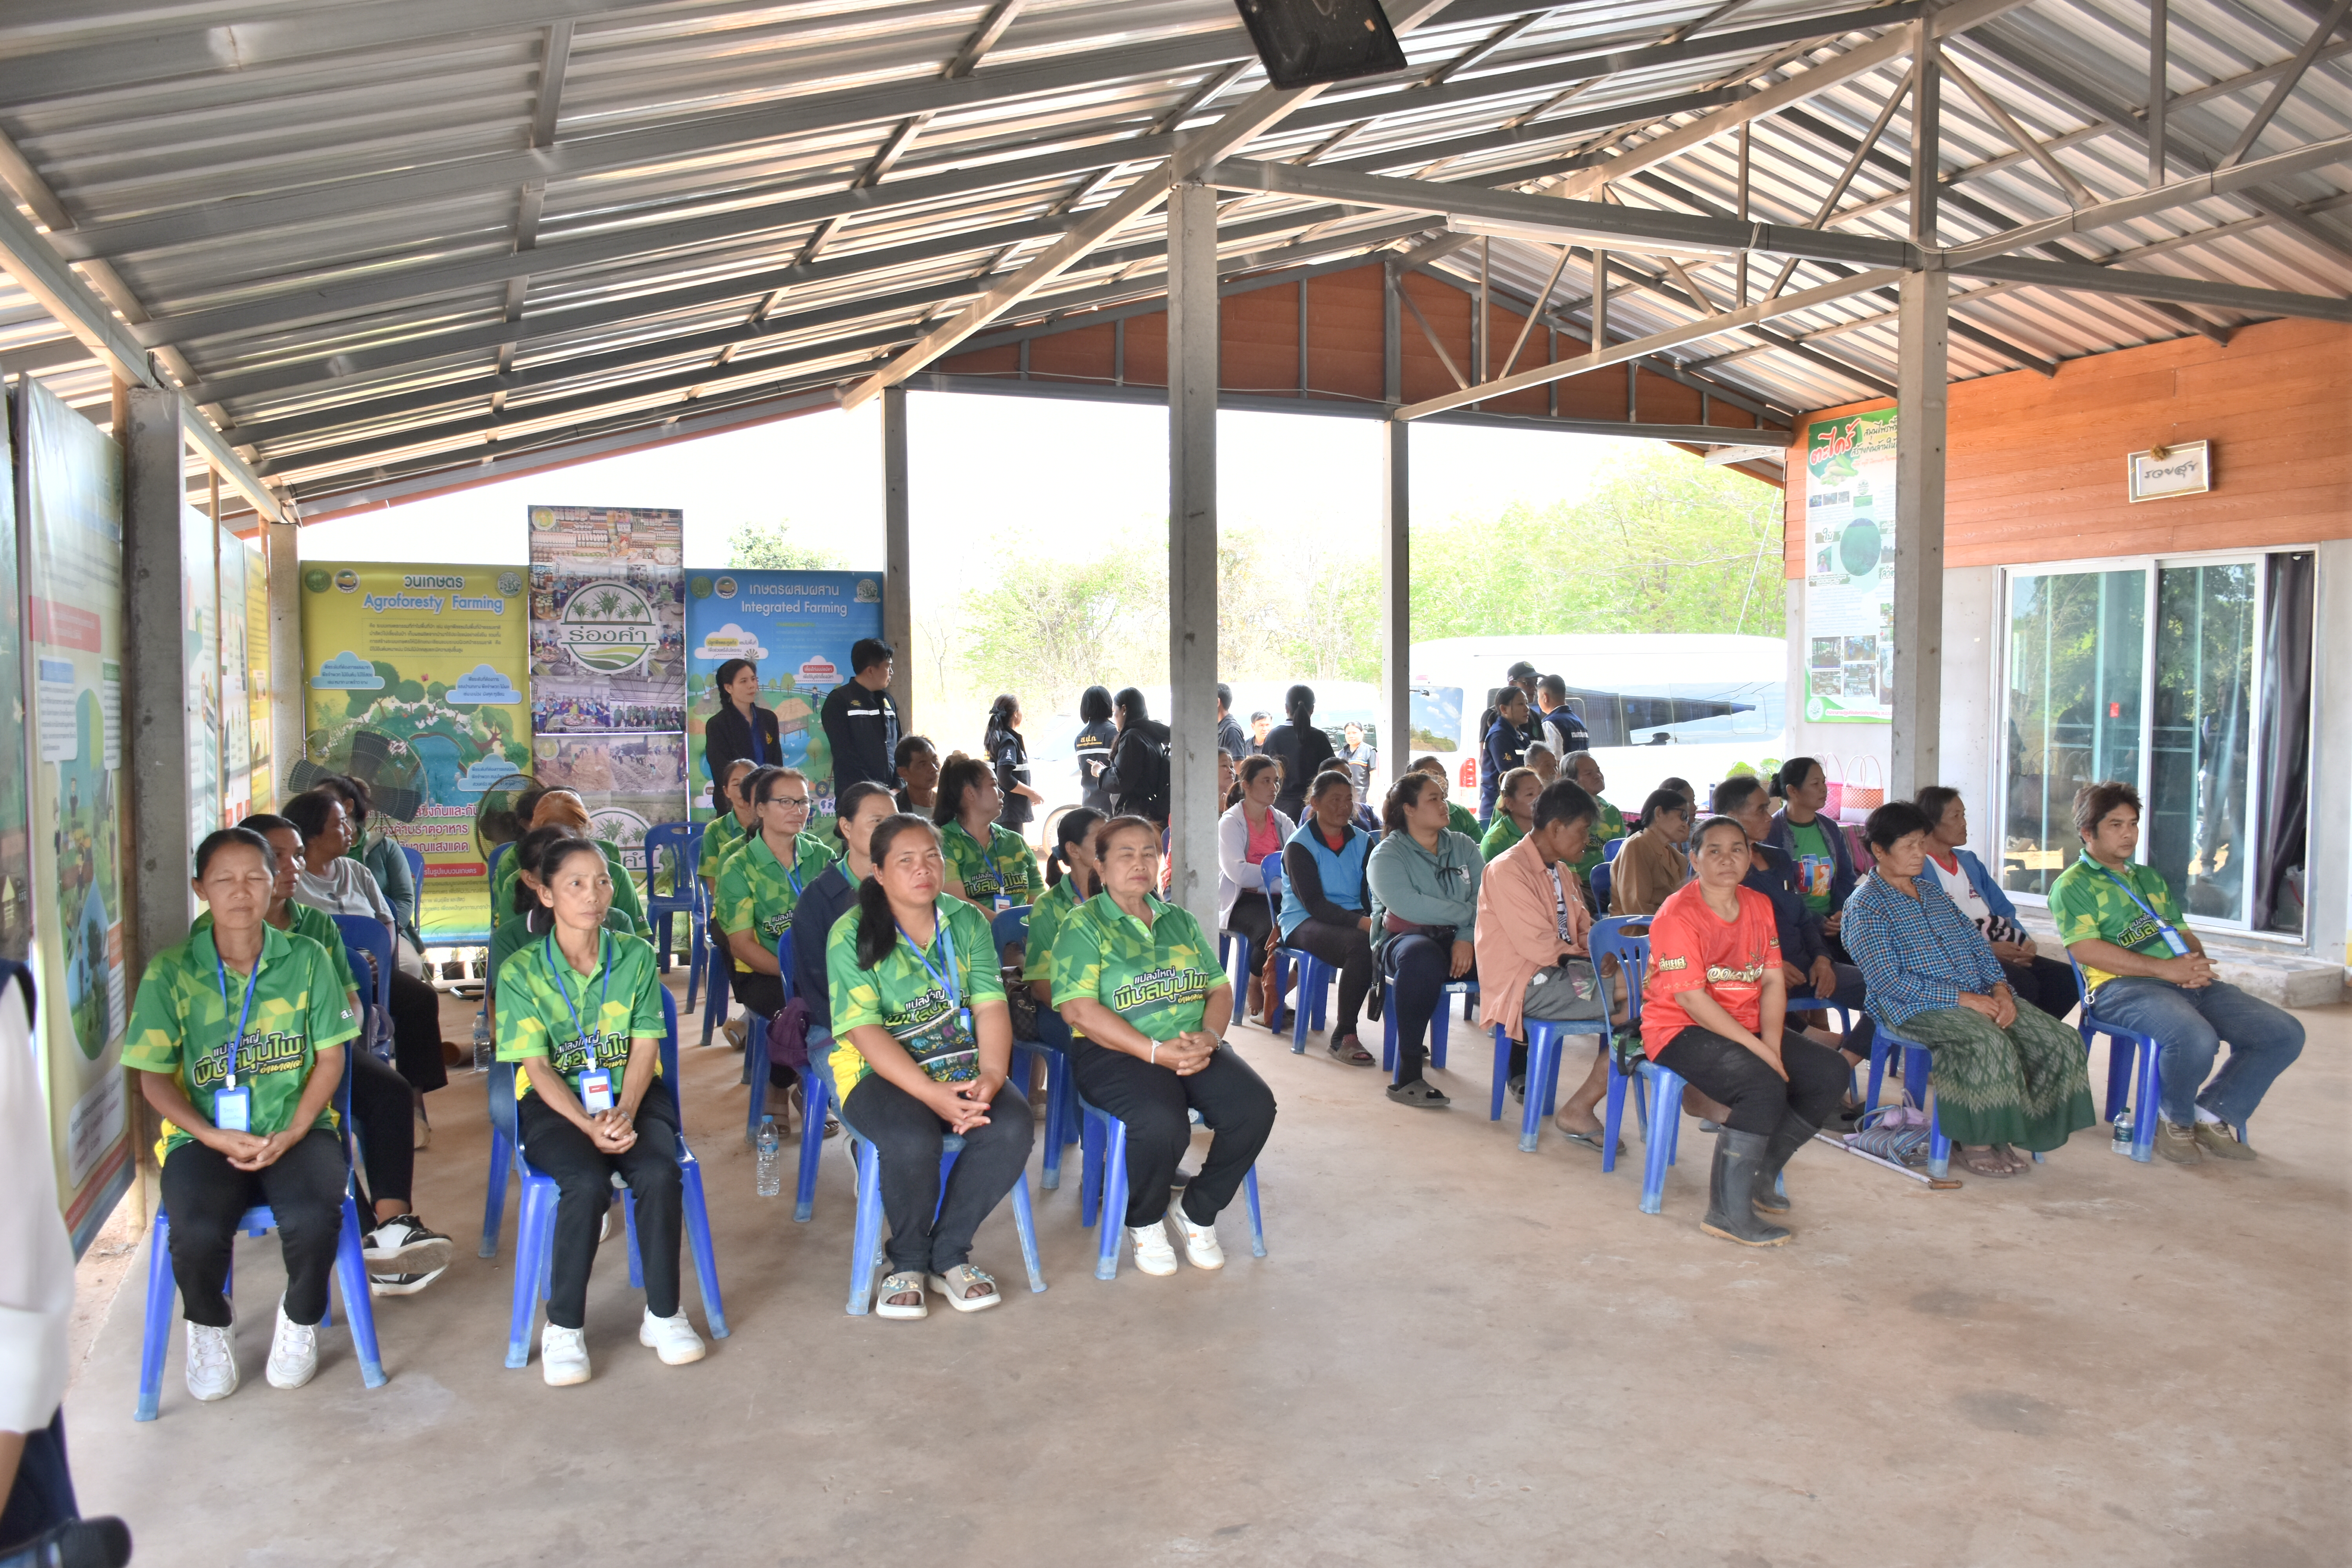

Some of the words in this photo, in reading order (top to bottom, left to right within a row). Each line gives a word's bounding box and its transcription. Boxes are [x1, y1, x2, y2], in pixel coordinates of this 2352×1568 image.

[1811, 419, 1860, 464] ตะไคร้
[1851, 437, 1897, 456] สร้างเงินล้านให้
[405, 575, 464, 588] วนเกษตร
[750, 584, 839, 596] เกษตรผสมผสาน
[363, 593, 443, 613] Agroforesty
[453, 595, 503, 613] Farming
[742, 601, 800, 617] Integrated
[805, 602, 847, 617] Farming
[569, 626, 647, 642] ร่องคำ
[424, 867, 477, 877] รในรูปแบบวนเกษตร
[1134, 966, 1176, 985] แปลงใหญ่
